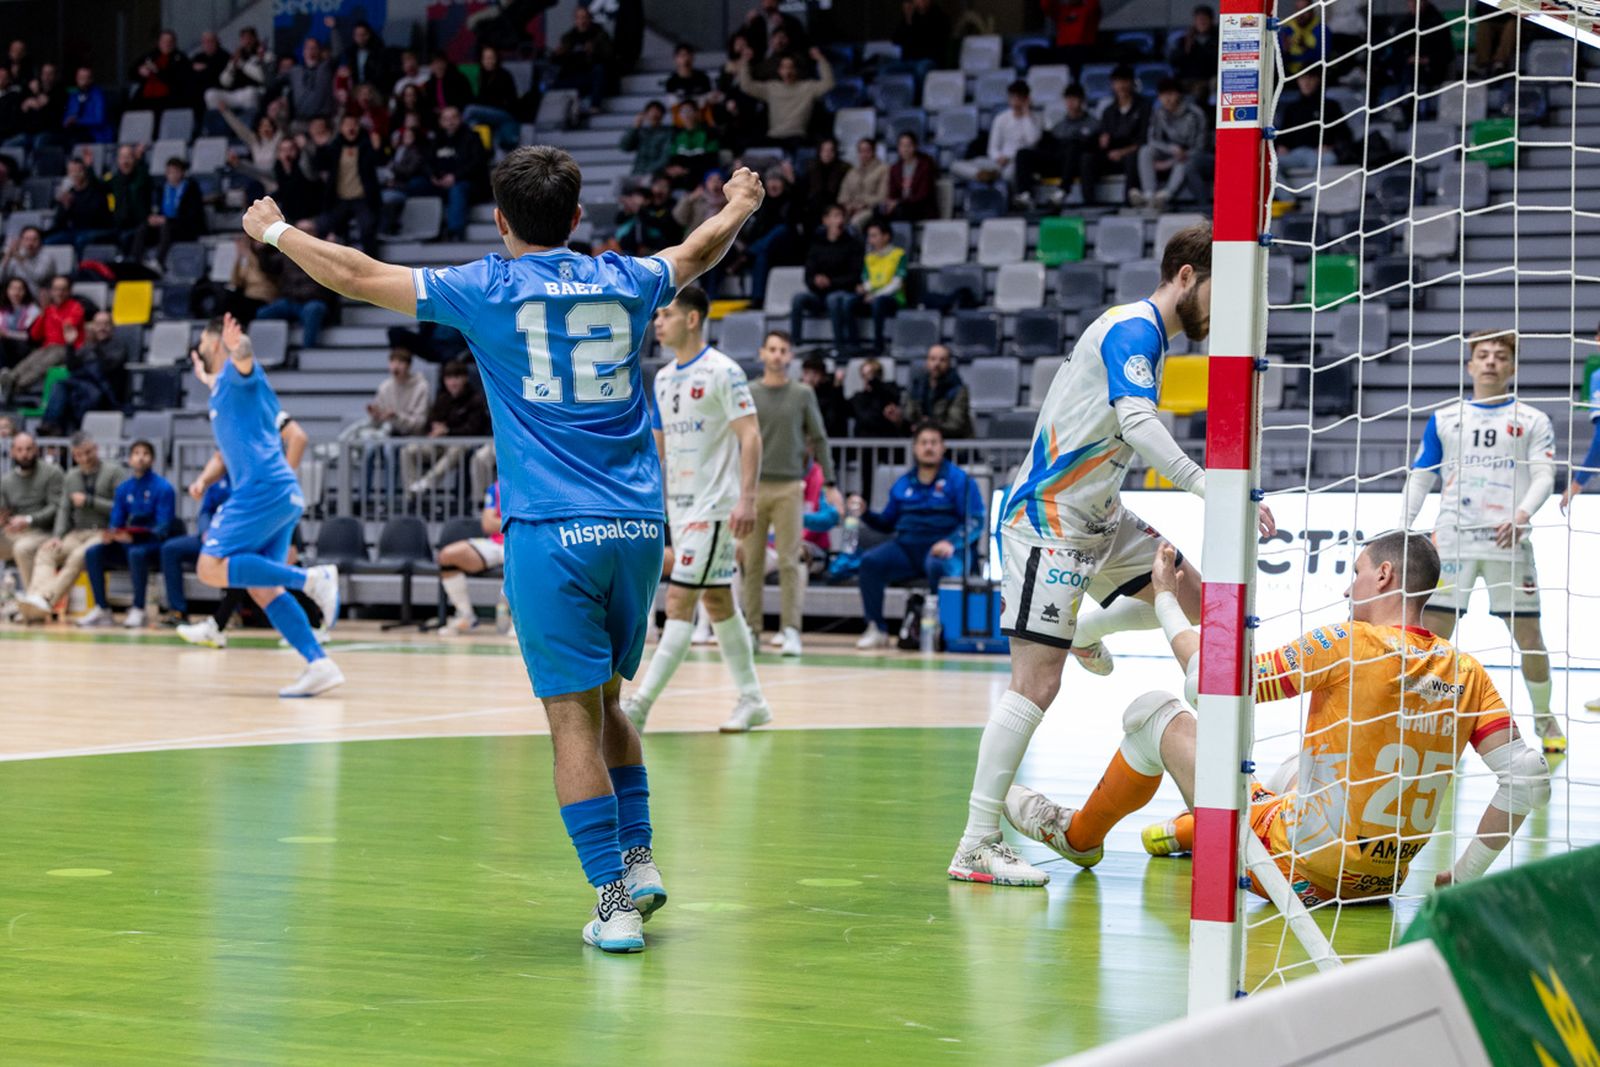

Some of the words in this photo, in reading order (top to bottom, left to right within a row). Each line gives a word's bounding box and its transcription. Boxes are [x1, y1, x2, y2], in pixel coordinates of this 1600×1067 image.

[515, 300, 634, 403] 12
[1472, 428, 1497, 448] 19
[559, 518, 658, 547] hispaloto
[1361, 742, 1456, 832] 25
